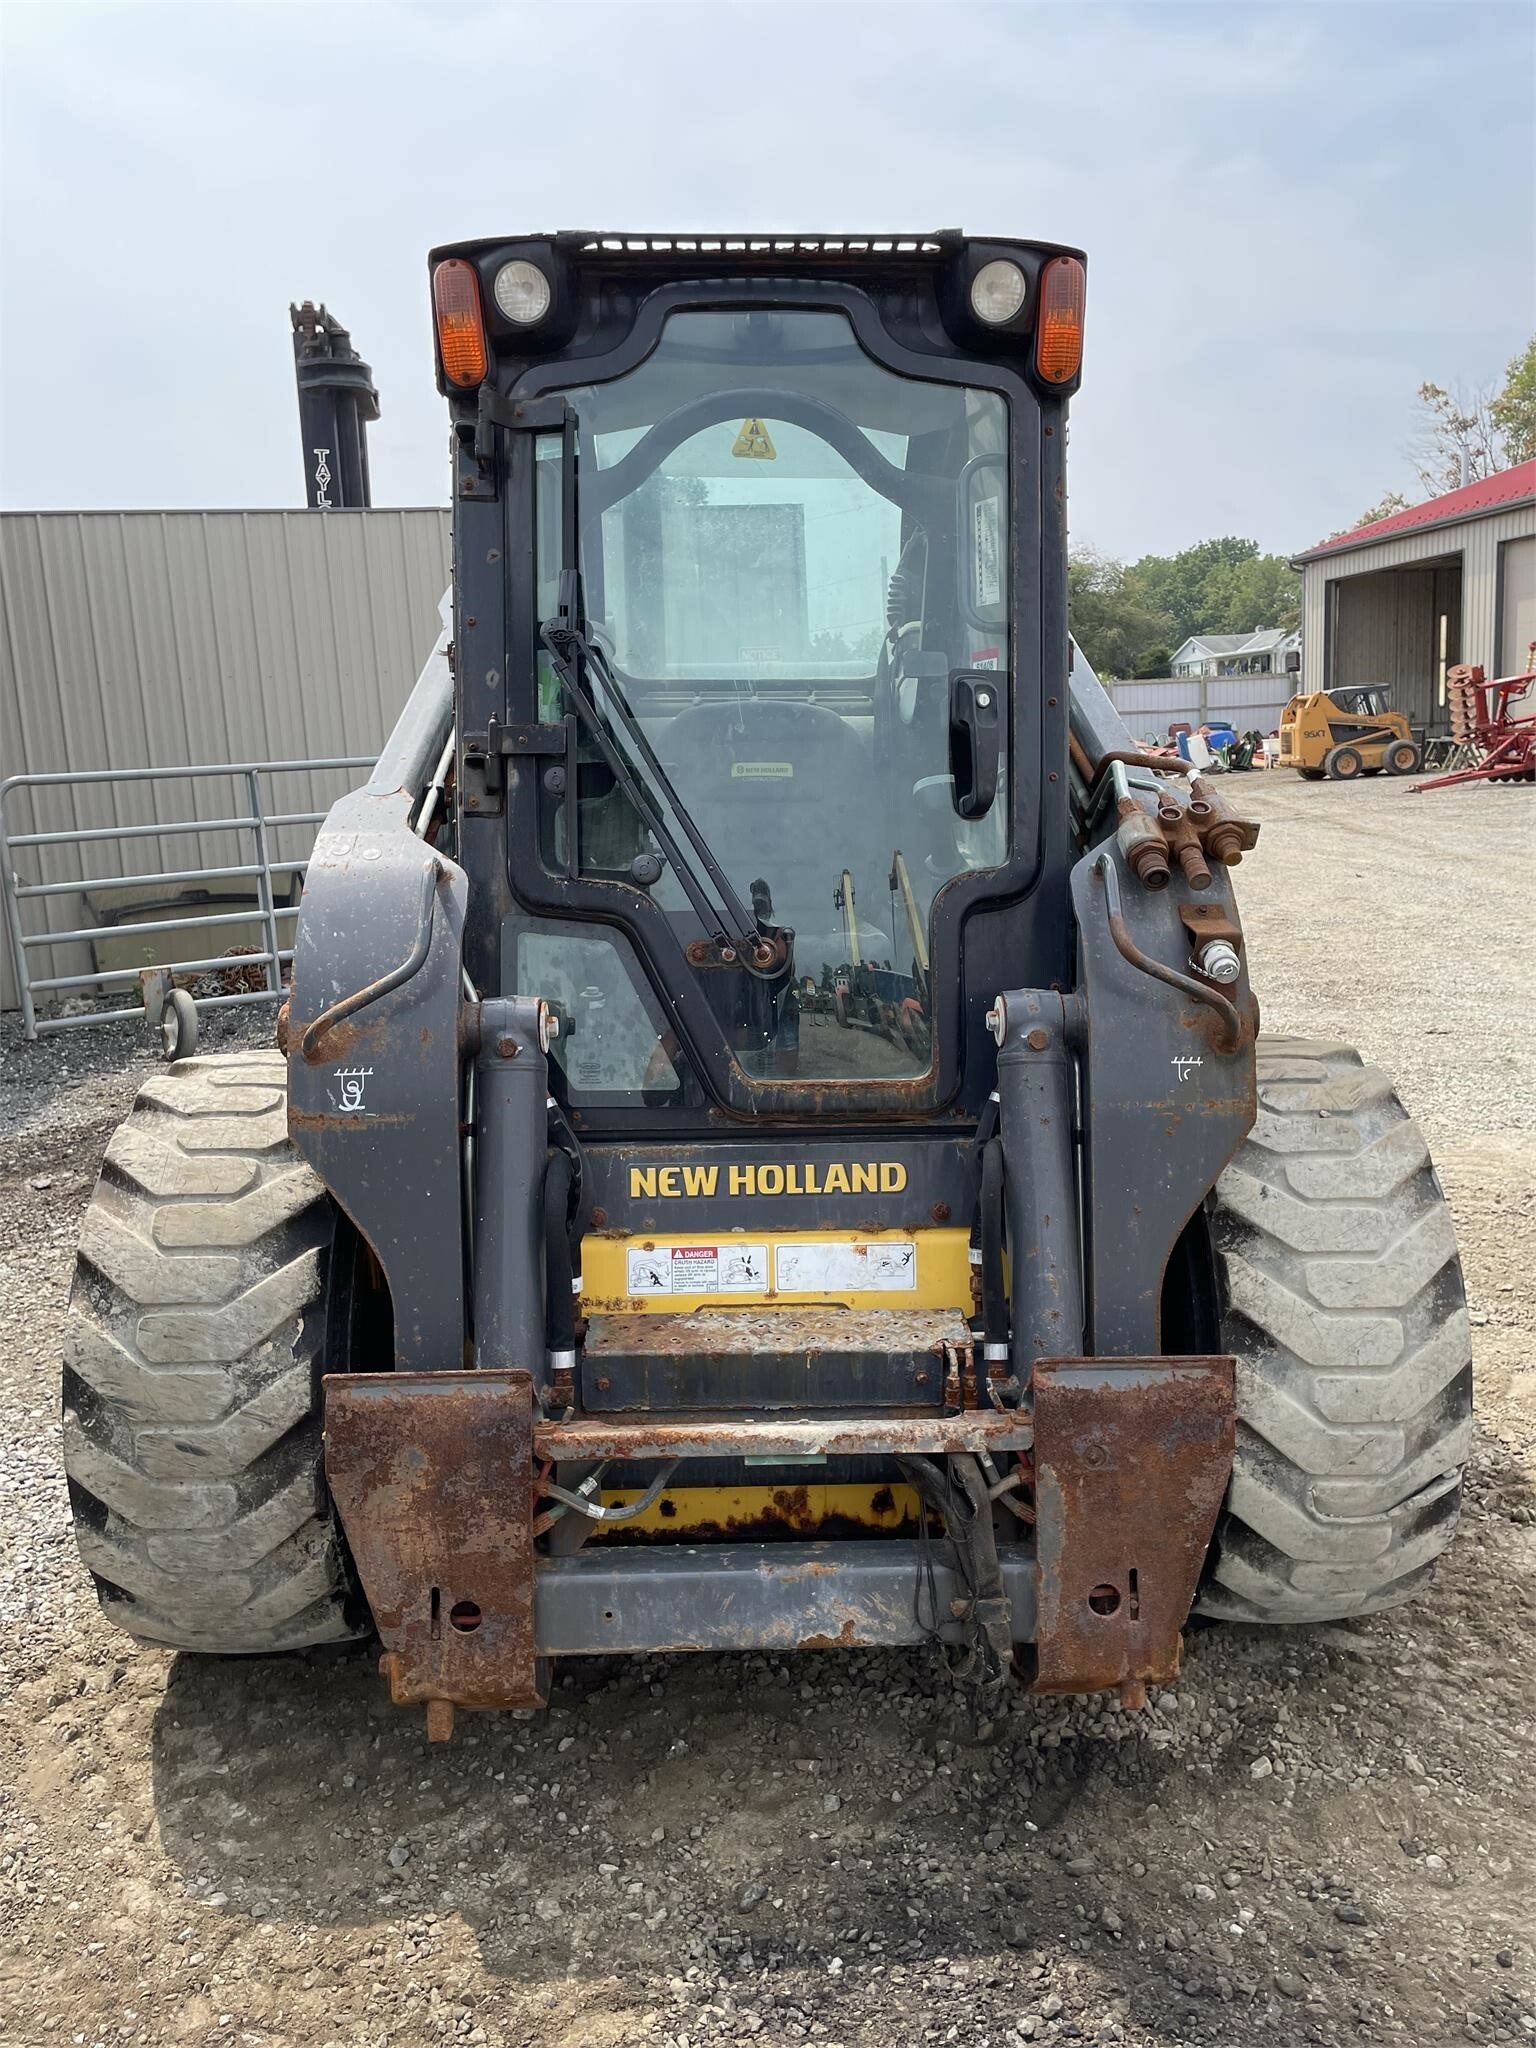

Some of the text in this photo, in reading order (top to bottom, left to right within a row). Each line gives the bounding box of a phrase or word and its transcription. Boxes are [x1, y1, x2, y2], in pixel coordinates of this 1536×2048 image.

[313, 448, 333, 509] TAYL
[629, 1162, 908, 1198] NEW HOLLAND
[684, 1250, 714, 1259] DANGER
